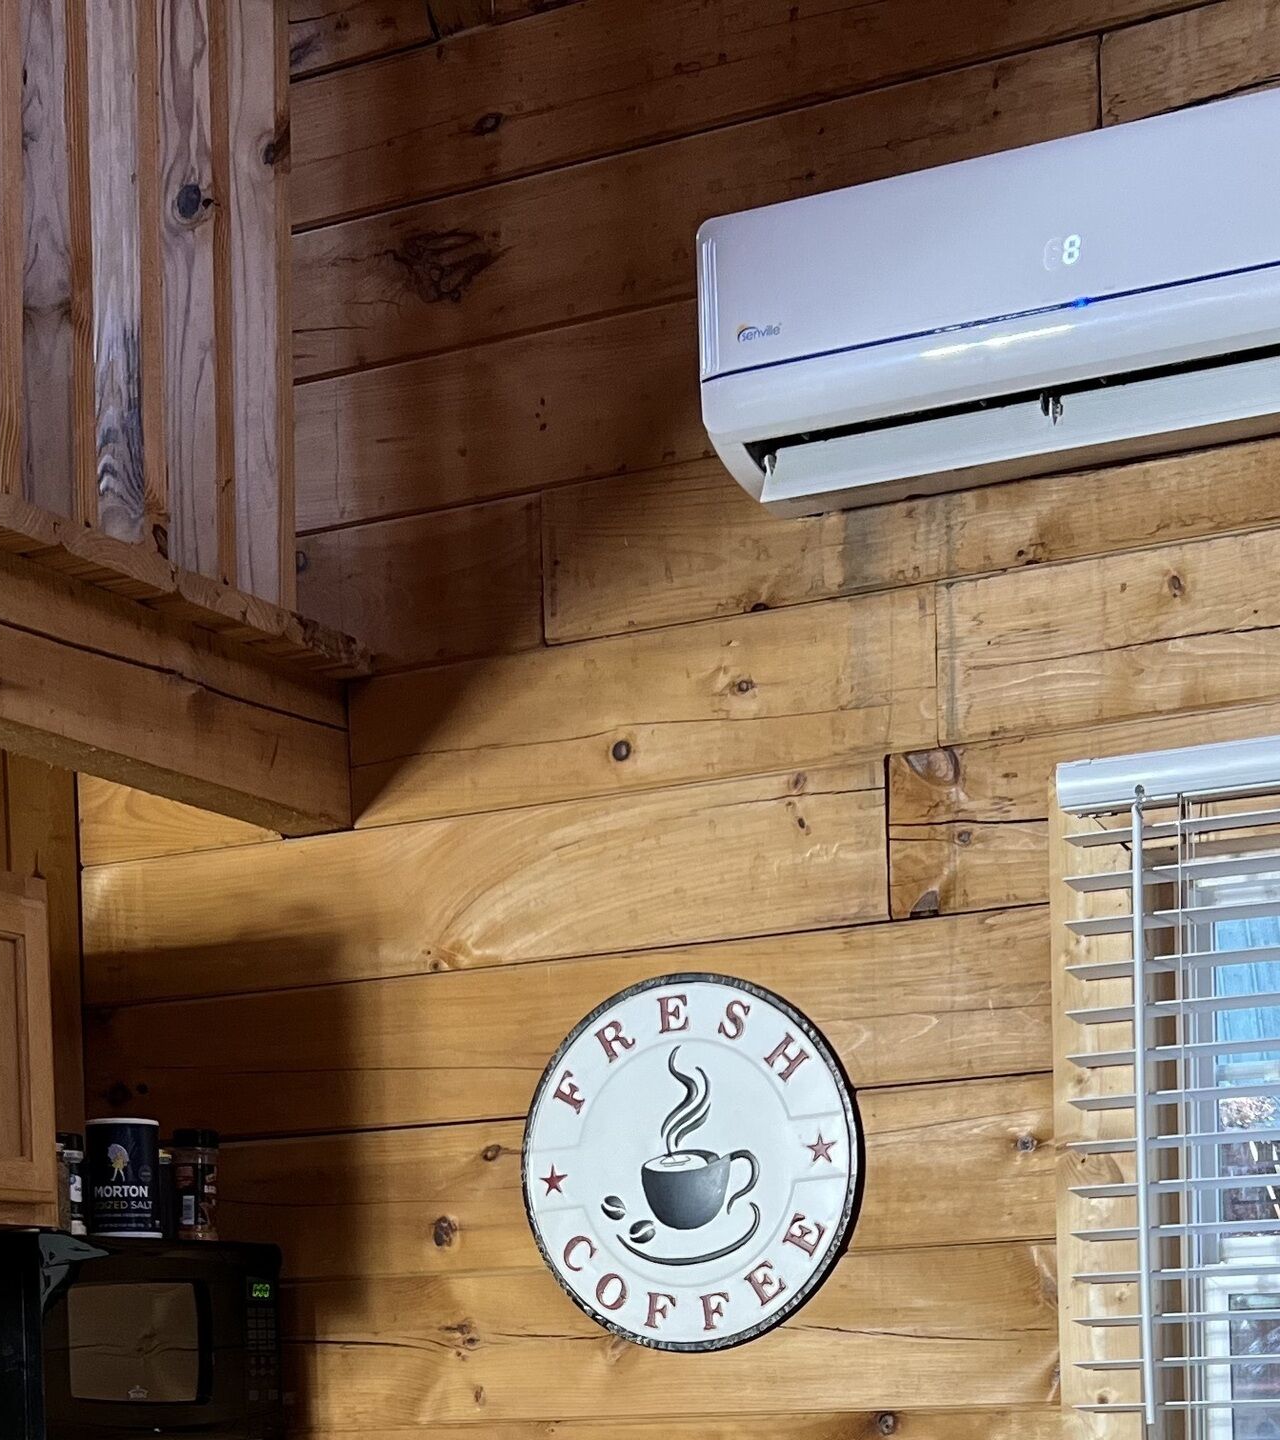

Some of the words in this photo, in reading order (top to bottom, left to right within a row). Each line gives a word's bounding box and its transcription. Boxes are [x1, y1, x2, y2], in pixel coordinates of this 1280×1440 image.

[553, 994, 810, 1115] FRESH
[94, 1185, 149, 1198] MORTON
[130, 1200, 153, 1210] SALT
[563, 1212, 826, 1331] COFFEE
